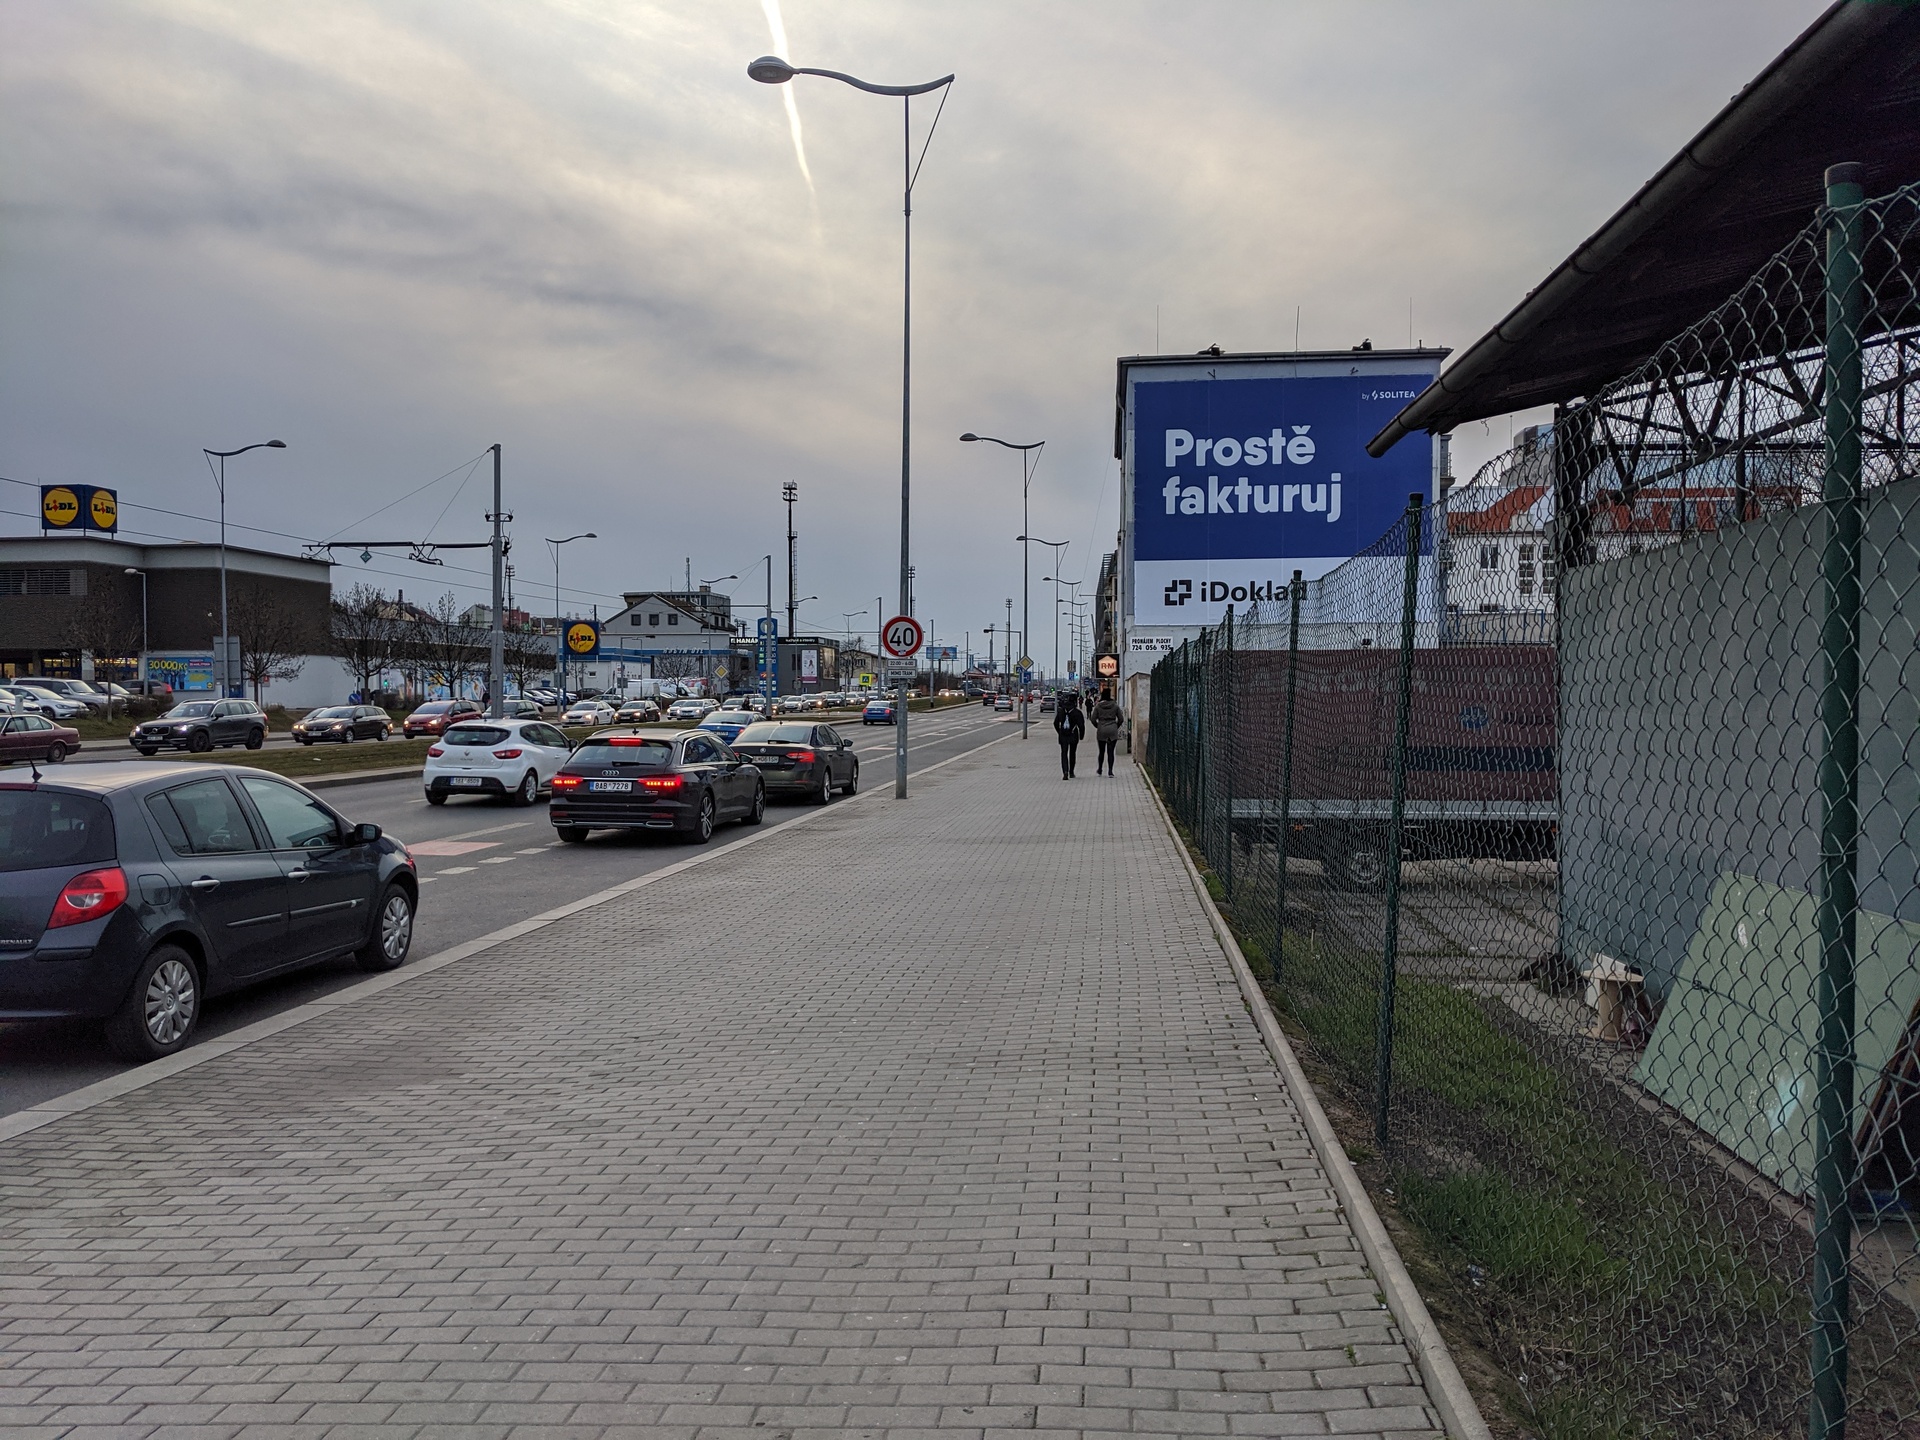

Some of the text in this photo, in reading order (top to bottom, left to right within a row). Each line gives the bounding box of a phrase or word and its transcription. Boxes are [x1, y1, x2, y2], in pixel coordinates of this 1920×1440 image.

[1361, 391, 1416, 401] by SOLITEA
[1165, 425, 1316, 467] Prostě
[1162, 472, 1342, 523] fakturuj
[889, 627, 914, 647] 40
[612, 782, 629, 790] 7278
